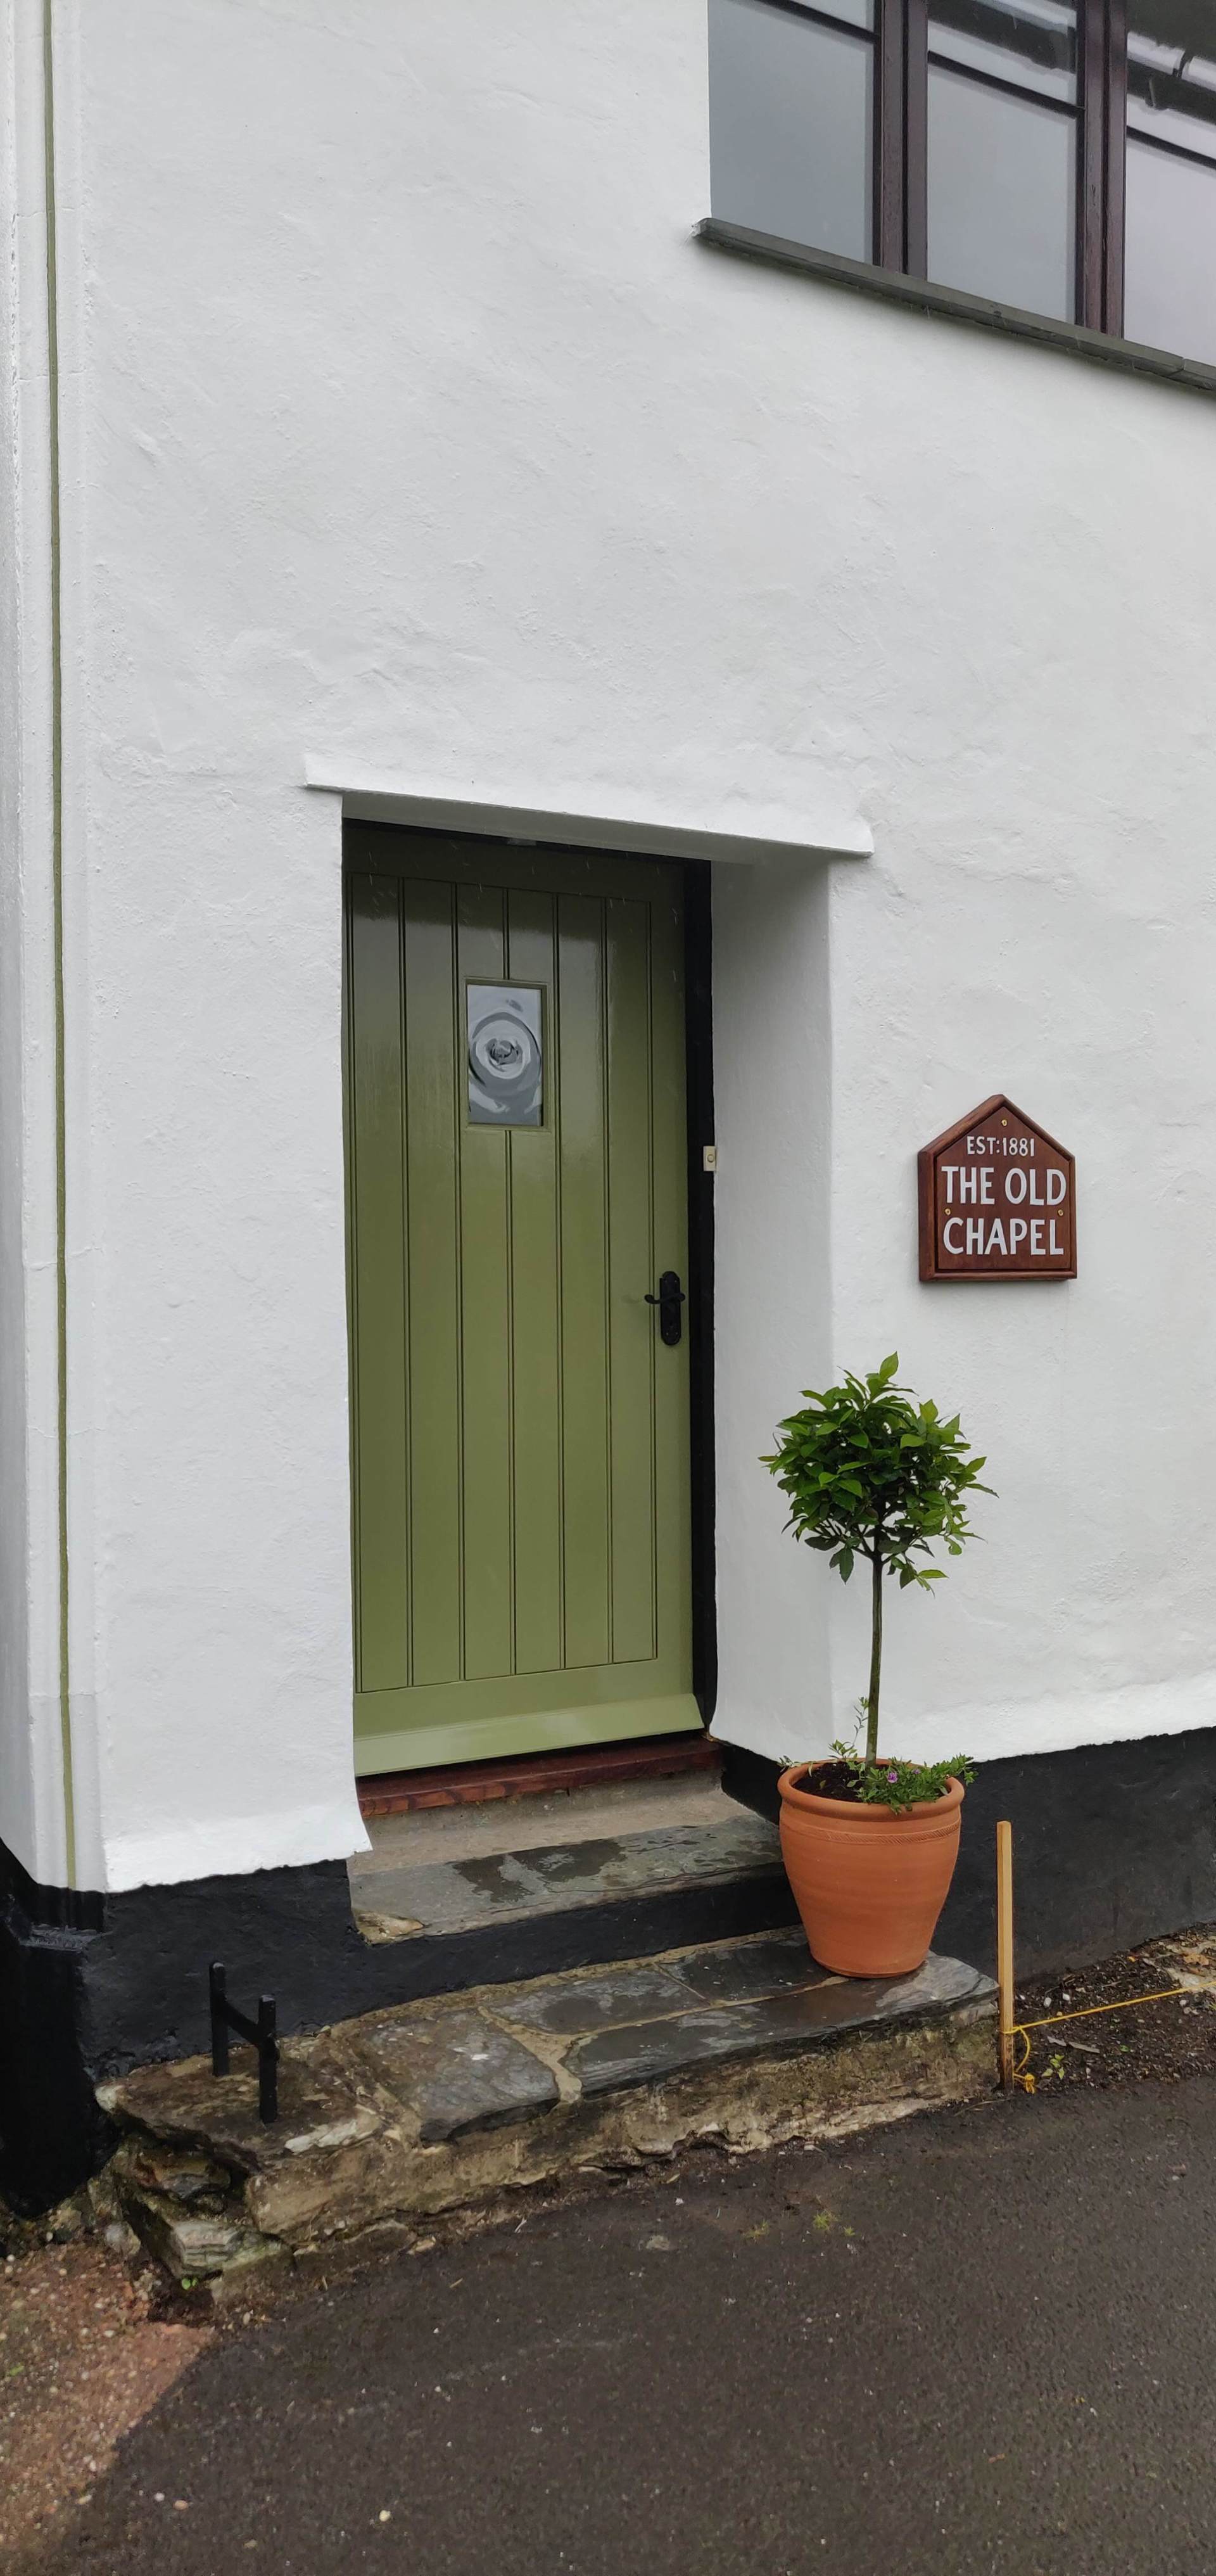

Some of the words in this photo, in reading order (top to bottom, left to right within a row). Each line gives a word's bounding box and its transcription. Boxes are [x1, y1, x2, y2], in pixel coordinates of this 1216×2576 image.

[966, 1135, 1035, 1157] EST:1881
[941, 1166, 995, 1204] THE
[1004, 1168, 1067, 1206] OLD
[943, 1217, 1064, 1256] CHAPEL
